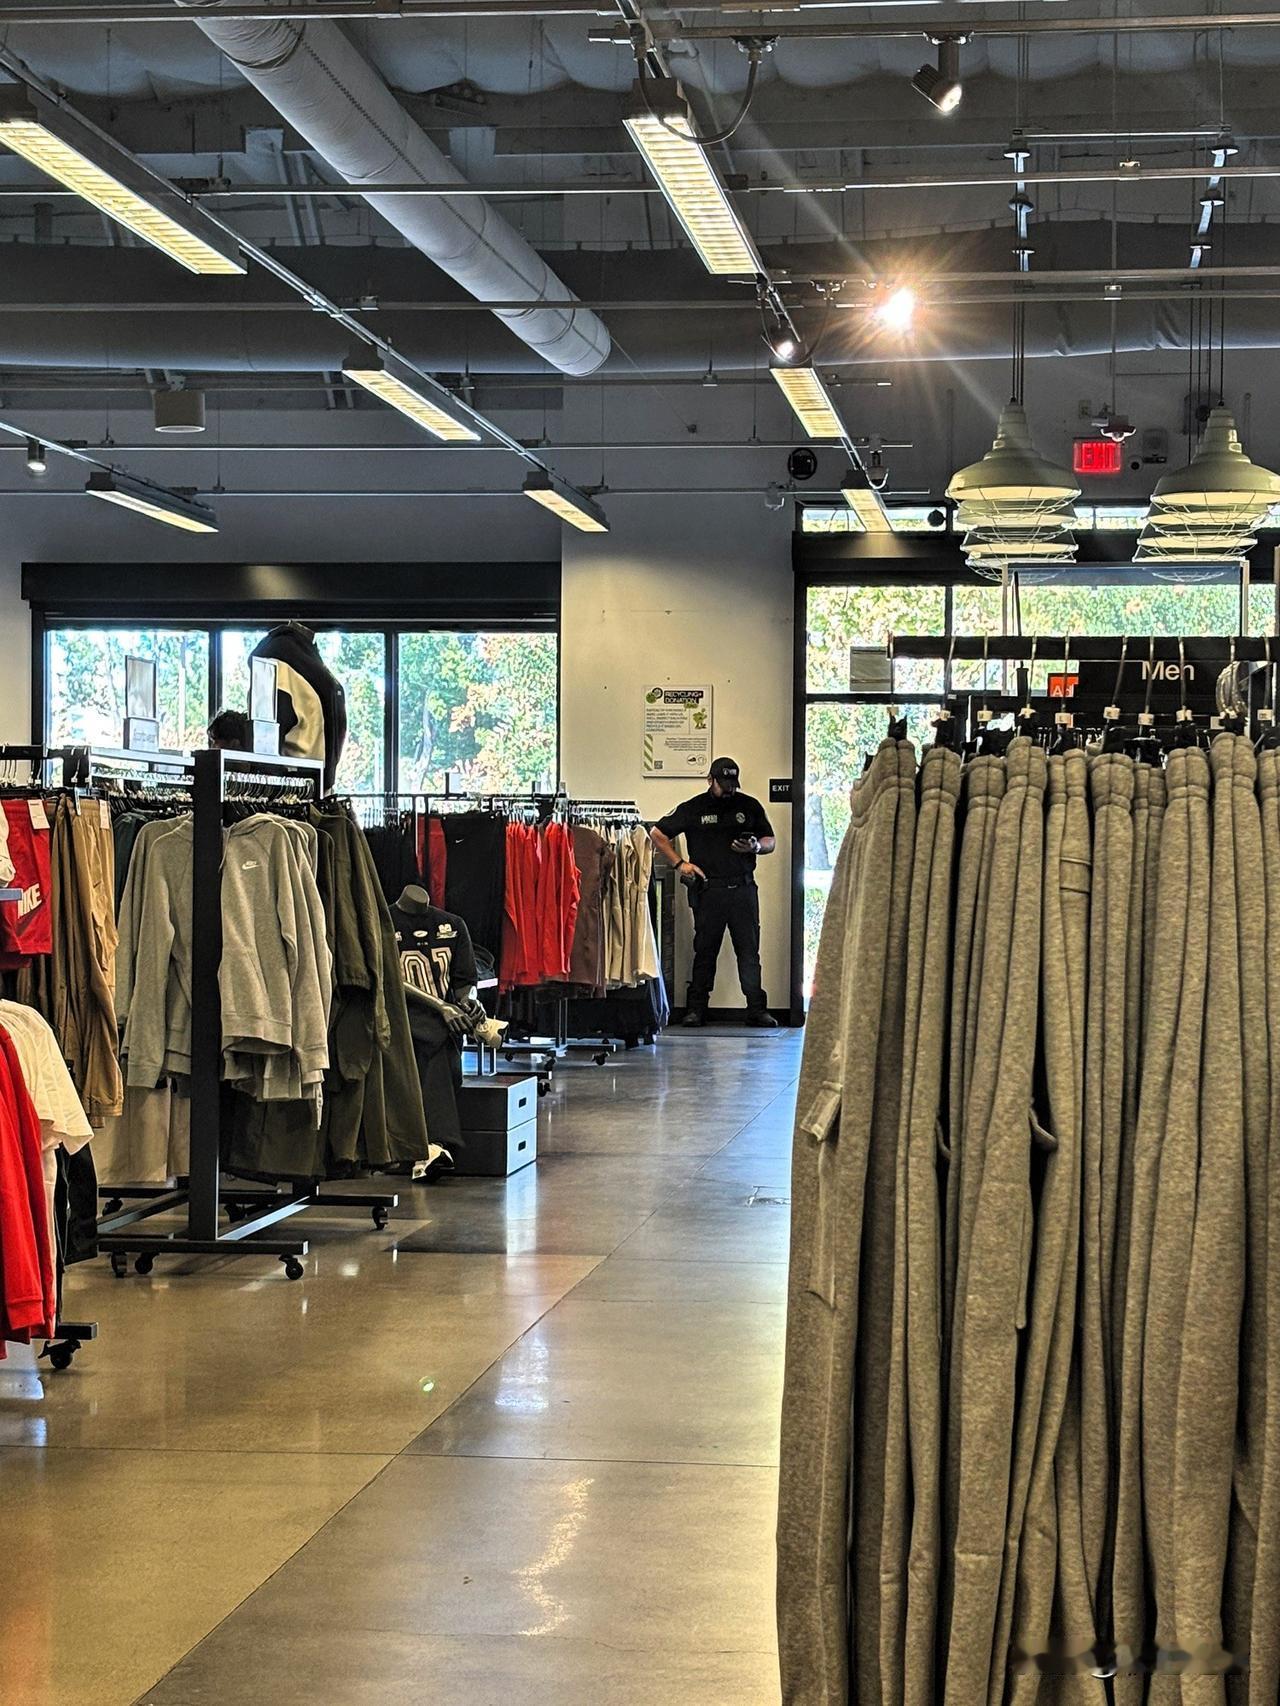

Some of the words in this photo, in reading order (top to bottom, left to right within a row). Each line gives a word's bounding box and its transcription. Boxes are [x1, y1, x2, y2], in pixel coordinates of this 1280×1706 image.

[1082, 443, 1116, 468] EXIT
[1141, 661, 1195, 681] Men
[772, 784, 790, 792] EXIT
